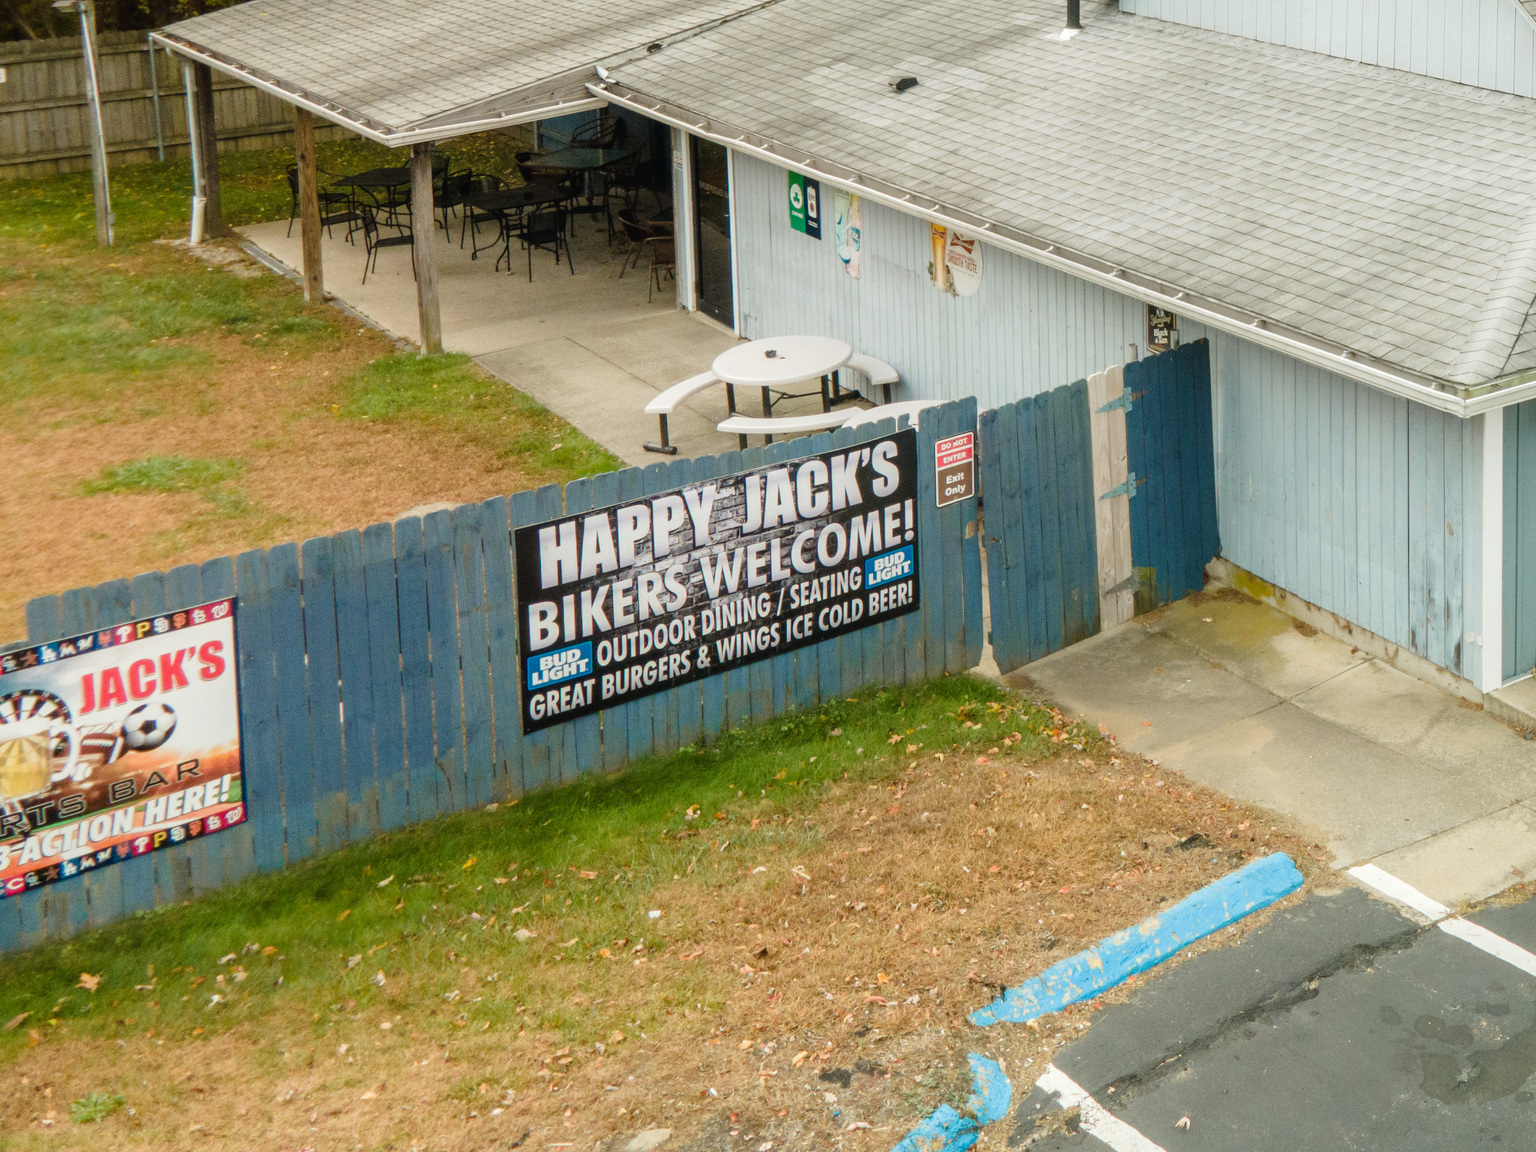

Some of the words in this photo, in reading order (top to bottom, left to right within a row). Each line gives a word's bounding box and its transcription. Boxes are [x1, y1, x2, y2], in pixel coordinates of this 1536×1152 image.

[941, 443, 951, 451] DO
[953, 438, 968, 447] NOT
[943, 452, 966, 464] ENTER
[945, 485, 966, 496] Only
[946, 472, 964, 484] Exit
[539, 486, 716, 589] HAPPY
[741, 440, 899, 535] JACK'S
[528, 565, 687, 650] BIKERS
[700, 499, 914, 599] WELCOME!
[868, 560, 912, 586] LIGHT
[874, 552, 905, 571] BUD
[597, 615, 696, 667] OUTDOOR
[702, 592, 771, 632] DINING
[790, 566, 862, 608] SEATING
[530, 680, 595, 720] GREAT
[602, 649, 691, 700] BURGERS
[697, 646, 711, 669] &
[716, 623, 780, 663] WINGS
[786, 611, 813, 642] ICE
[818, 595, 863, 631] COLD
[868, 580, 913, 617] BEER!
[540, 648, 581, 671] BUD
[79, 640, 226, 716] JACK'S
[532, 658, 589, 686] LIGHT
[108, 758, 202, 804] BAR
[18, 809, 134, 866] ACTION
[144, 774, 231, 827] HERE!
